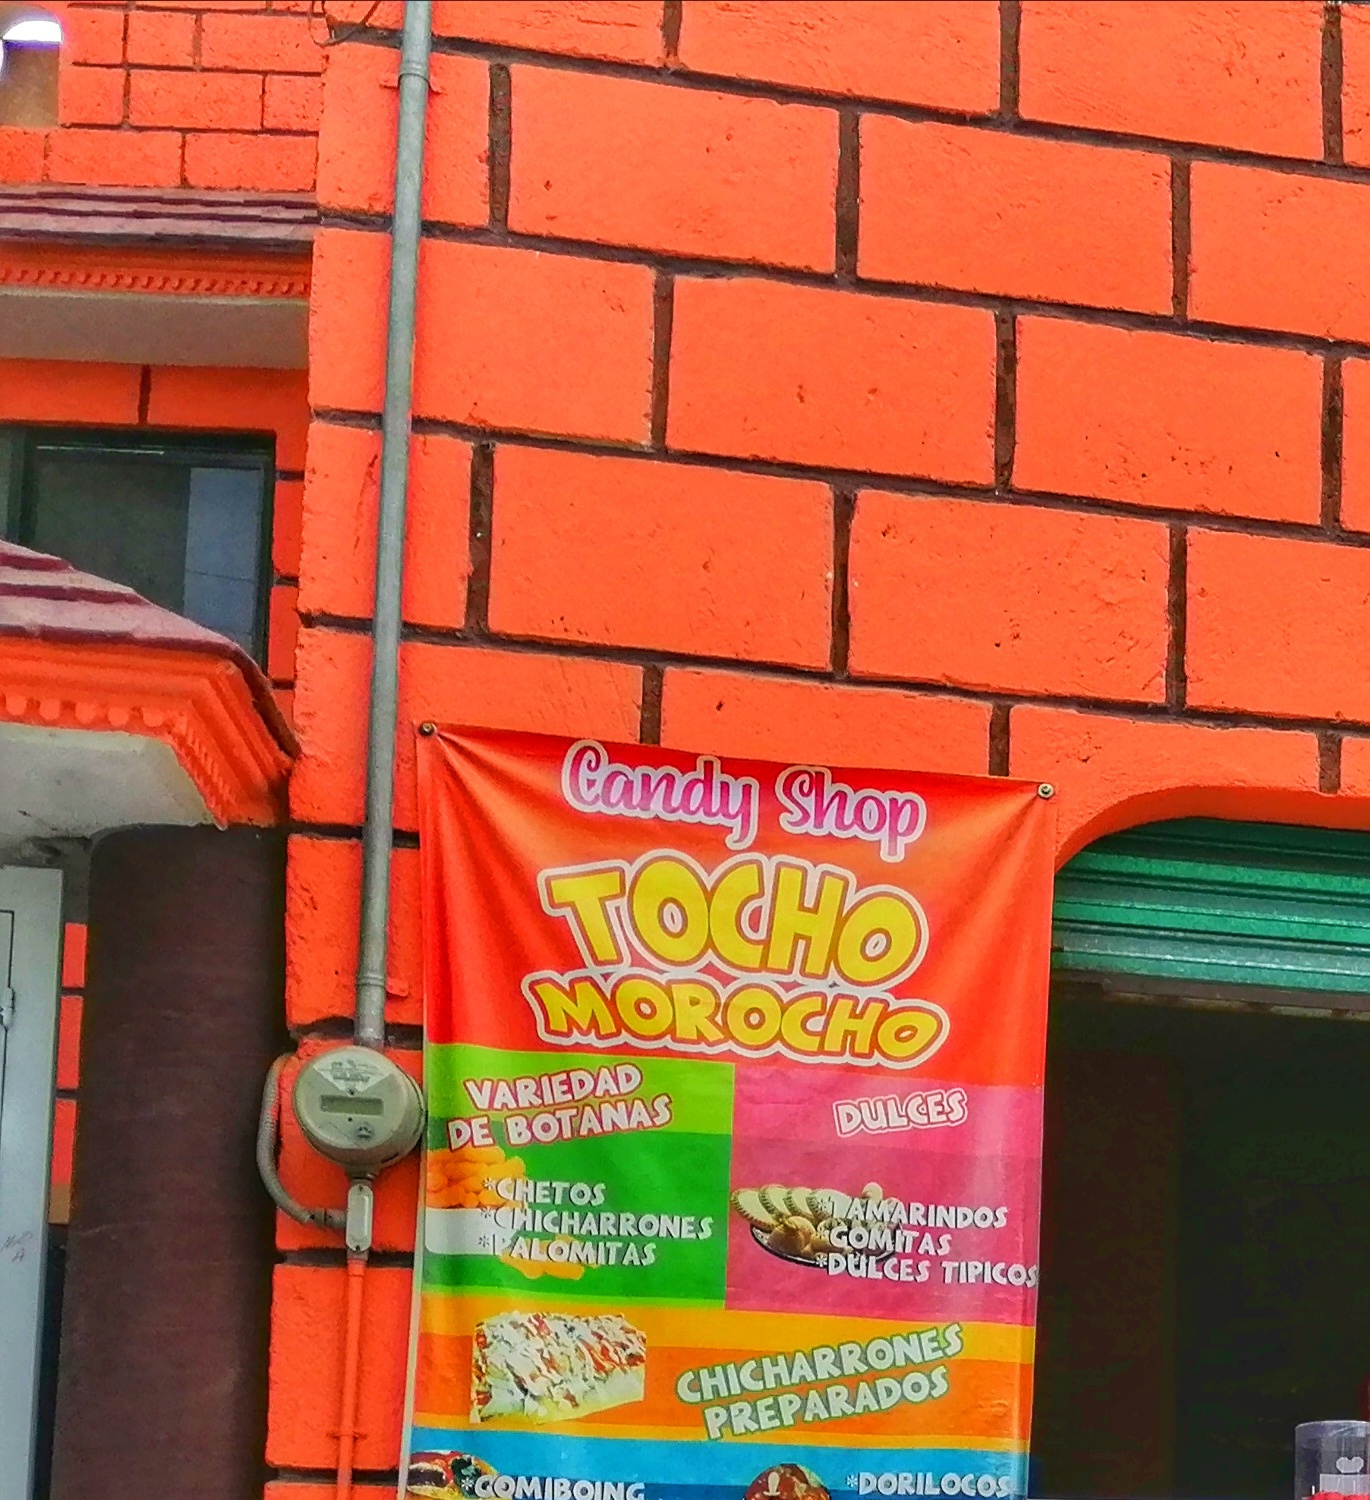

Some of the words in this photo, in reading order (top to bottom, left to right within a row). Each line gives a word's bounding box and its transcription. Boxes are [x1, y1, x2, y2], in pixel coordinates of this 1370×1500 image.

[562, 740, 757, 849] Candy
[775, 766, 927, 862] Shop
[541, 853, 927, 987] TOCHO
[524, 973, 948, 1066] MOROCHO
[464, 1063, 643, 1111] VARIEDAD
[447, 1116, 495, 1149] DE
[505, 1094, 672, 1146] BOTANAS
[833, 1088, 968, 1138] DULCES
[496, 1178, 606, 1207] CHETOS
[830, 1197, 1010, 1229] TAMARINDOS
[494, 1207, 714, 1240] CHICHARRONES
[829, 1225, 953, 1256] GOMITAS
[492, 1233, 657, 1266] PALOMITAS
[827, 1252, 931, 1283] DULCES
[942, 1260, 1039, 1288] TIPICOS
[675, 1323, 964, 1404] CHICHARRONES
[703, 1365, 949, 1440] PREPARADOS
[857, 1472, 1012, 1498] DORILOCOS
